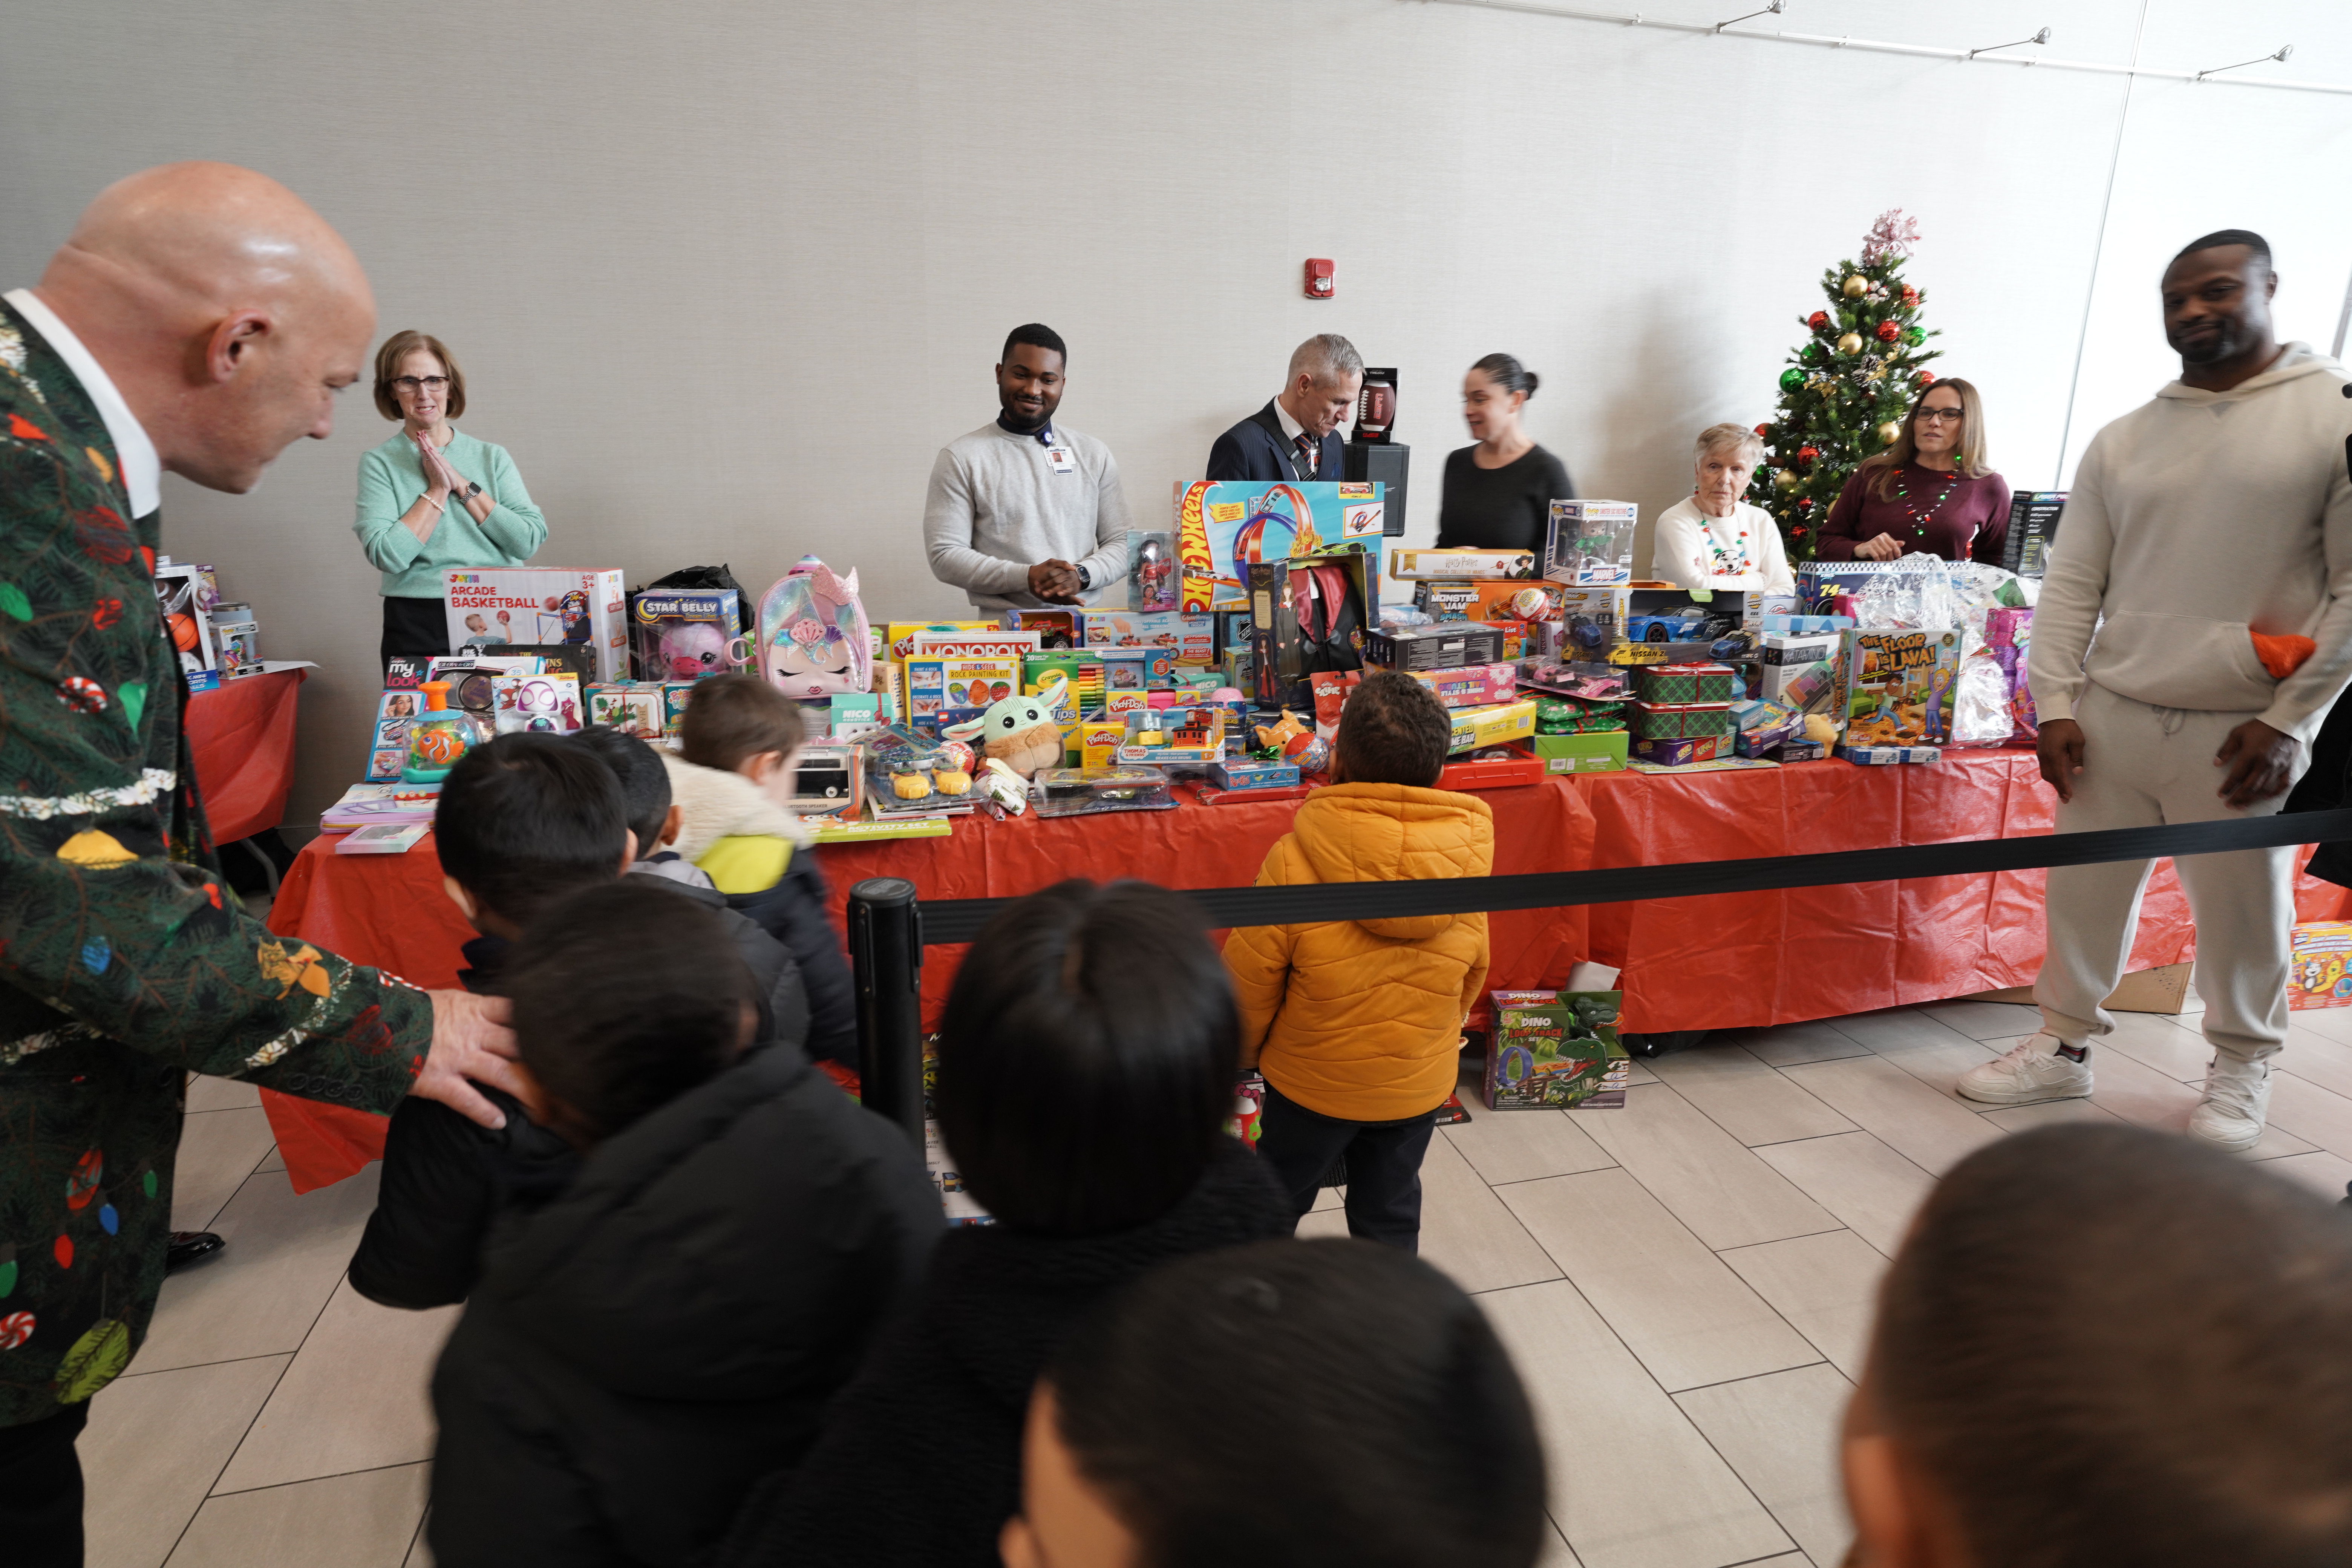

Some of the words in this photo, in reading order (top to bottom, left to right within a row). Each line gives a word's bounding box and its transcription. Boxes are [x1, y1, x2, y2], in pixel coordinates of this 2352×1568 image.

[1585, 508, 1599, 517] POP!
[1592, 569, 1616, 580] MARVEL
[450, 586, 496, 596] ARCADE
[1820, 584, 1841, 597] 74
[451, 597, 539, 608] BASKETBALL
[646, 602, 678, 613] STAR
[680, 602, 717, 613] BELLY
[1859, 635, 1880, 648] THE
[1880, 634, 1925, 654] FLOOR
[925, 644, 1032, 660] MONOPOLY
[1782, 647, 1826, 663] KATAMINO
[1890, 646, 1936, 671] LAVA!
[389, 663, 415, 678] my
[386, 672, 422, 688] look
[1041, 672, 1063, 682] Crayola
[1315, 686, 1341, 697] SLIME
[1438, 681, 1467, 691] STUDIO
[1109, 698, 1145, 712] Play-Doh
[842, 710, 871, 719] NICO
[1051, 708, 1076, 720] Tips
[1086, 733, 1119, 746] Play-Doh
[1461, 733, 1476, 744] BAR
[1717, 736, 1732, 750] UNO
[1637, 741, 1653, 752] UNO
[1677, 743, 1693, 759] UNO
[1696, 740, 1714, 756] UNO
[1521, 1017, 1552, 1027] DINO
[1509, 1029, 1532, 1039] LOOP
[1535, 1027, 1563, 1037] TRACK
